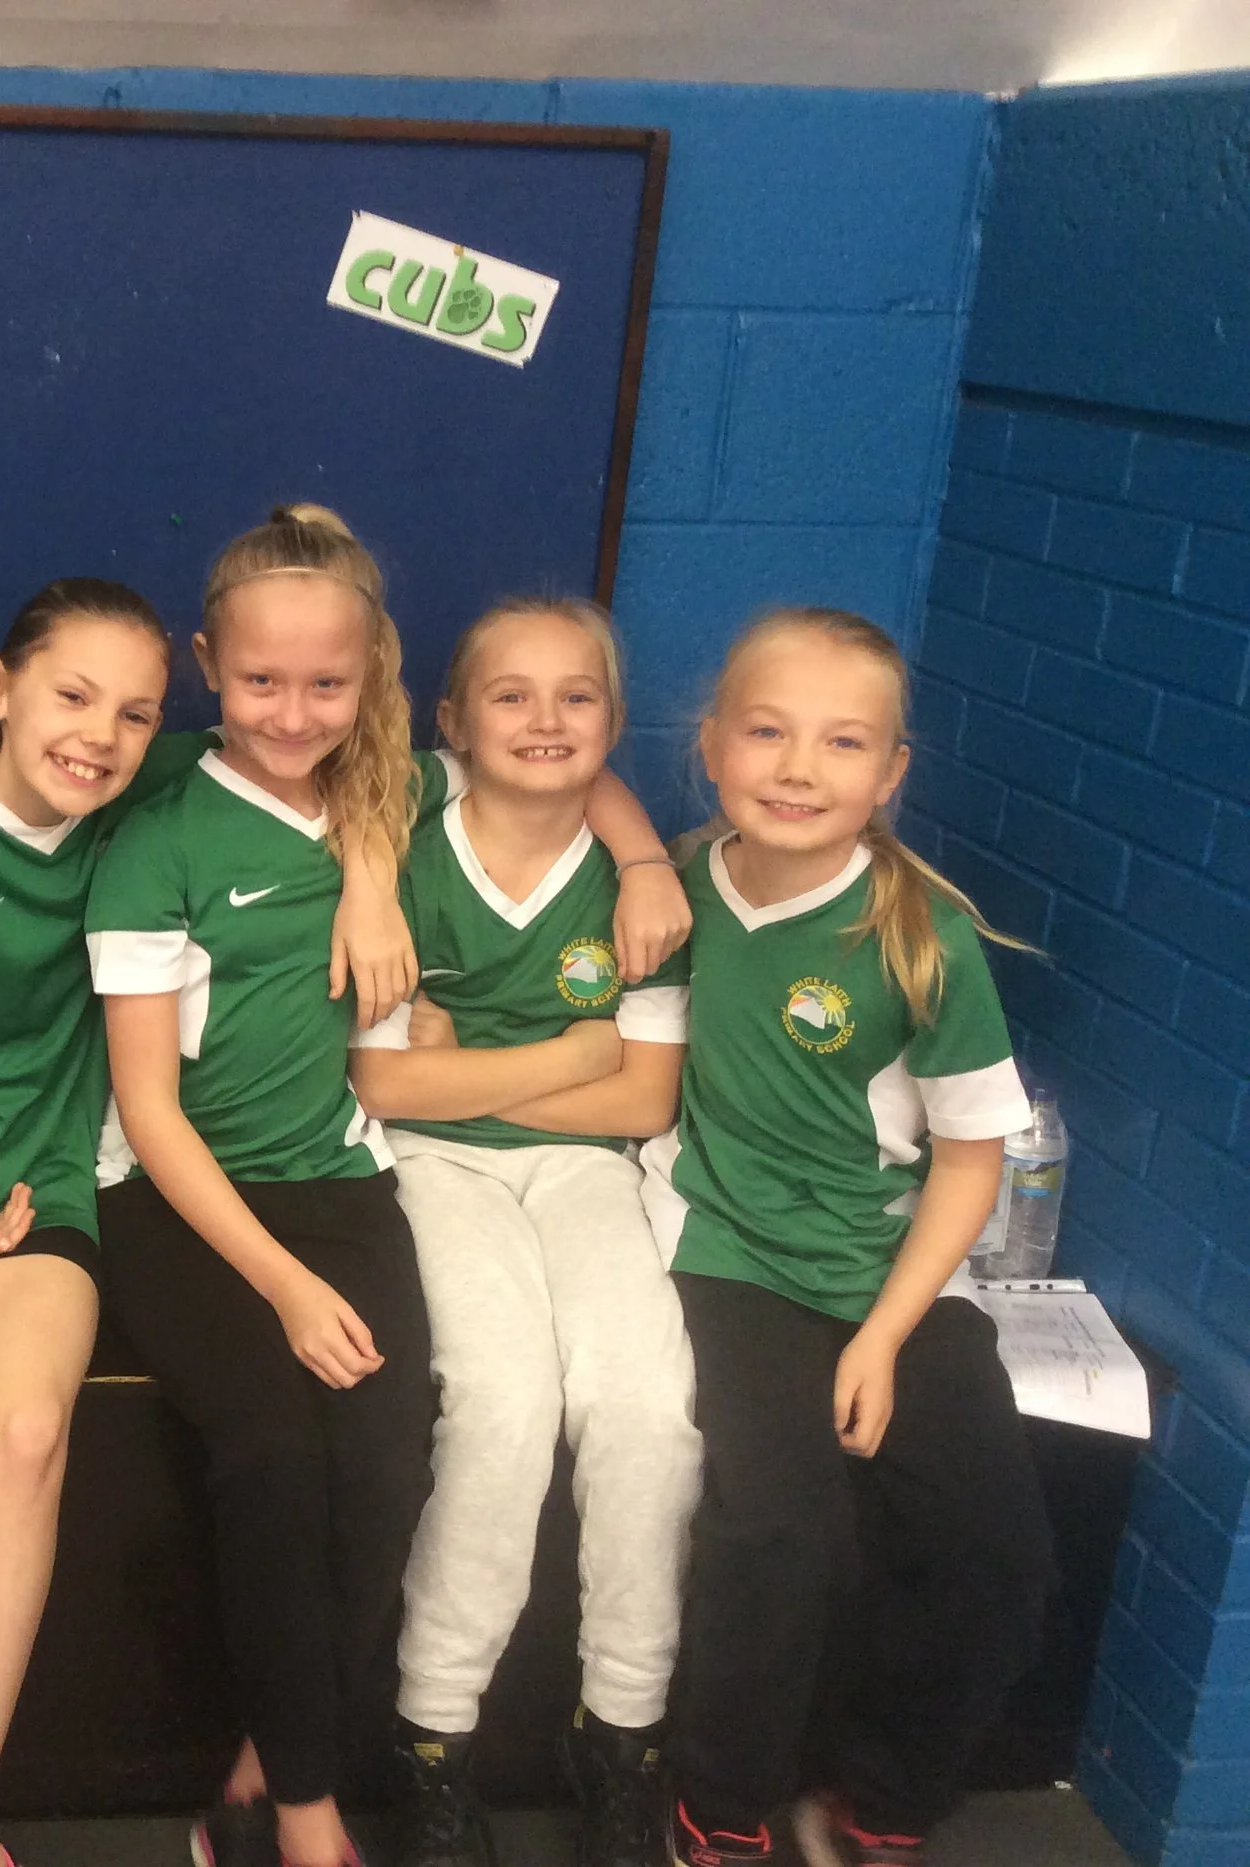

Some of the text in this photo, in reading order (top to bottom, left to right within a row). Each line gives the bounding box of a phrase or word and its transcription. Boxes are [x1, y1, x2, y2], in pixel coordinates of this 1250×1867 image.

[345, 249, 536, 353] cubs
[558, 937, 588, 960] WHITE
[590, 976, 623, 1007] SCHOO
[786, 976, 821, 995] WHITE
[816, 1020, 855, 1054] SCHOOL
